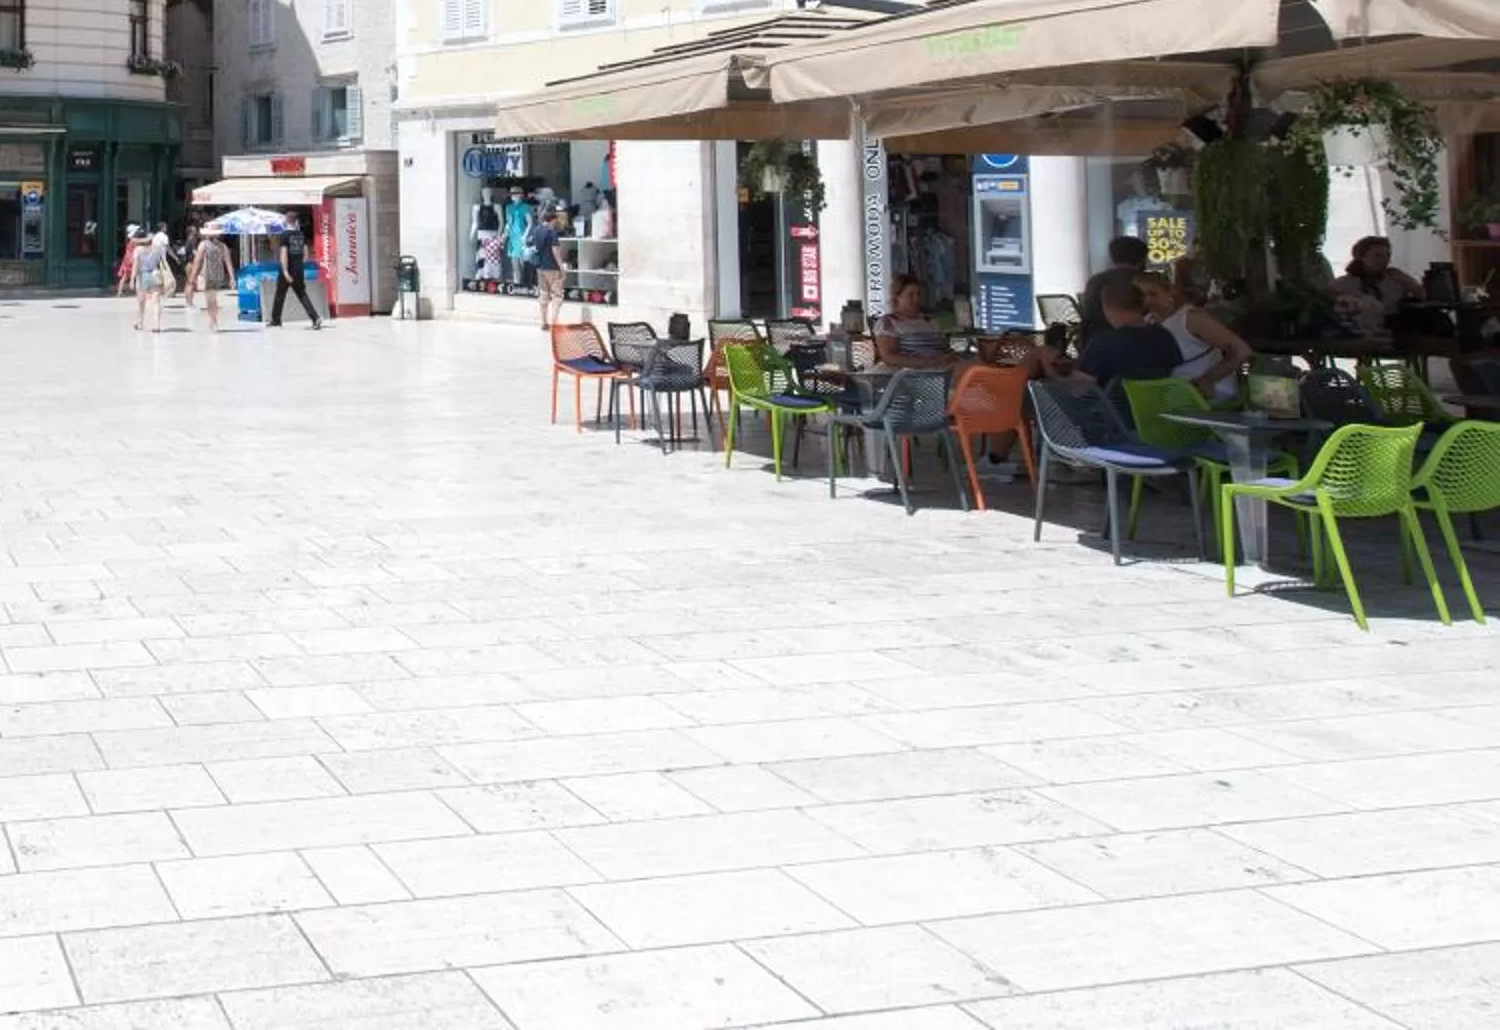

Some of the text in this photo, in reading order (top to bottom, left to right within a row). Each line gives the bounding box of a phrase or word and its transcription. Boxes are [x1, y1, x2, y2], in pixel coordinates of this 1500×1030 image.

[865, 137, 881, 180] ONL
[1147, 217, 1187, 228] SALE
[1168, 229, 1187, 239] TO
[1147, 237, 1187, 250] 50%
